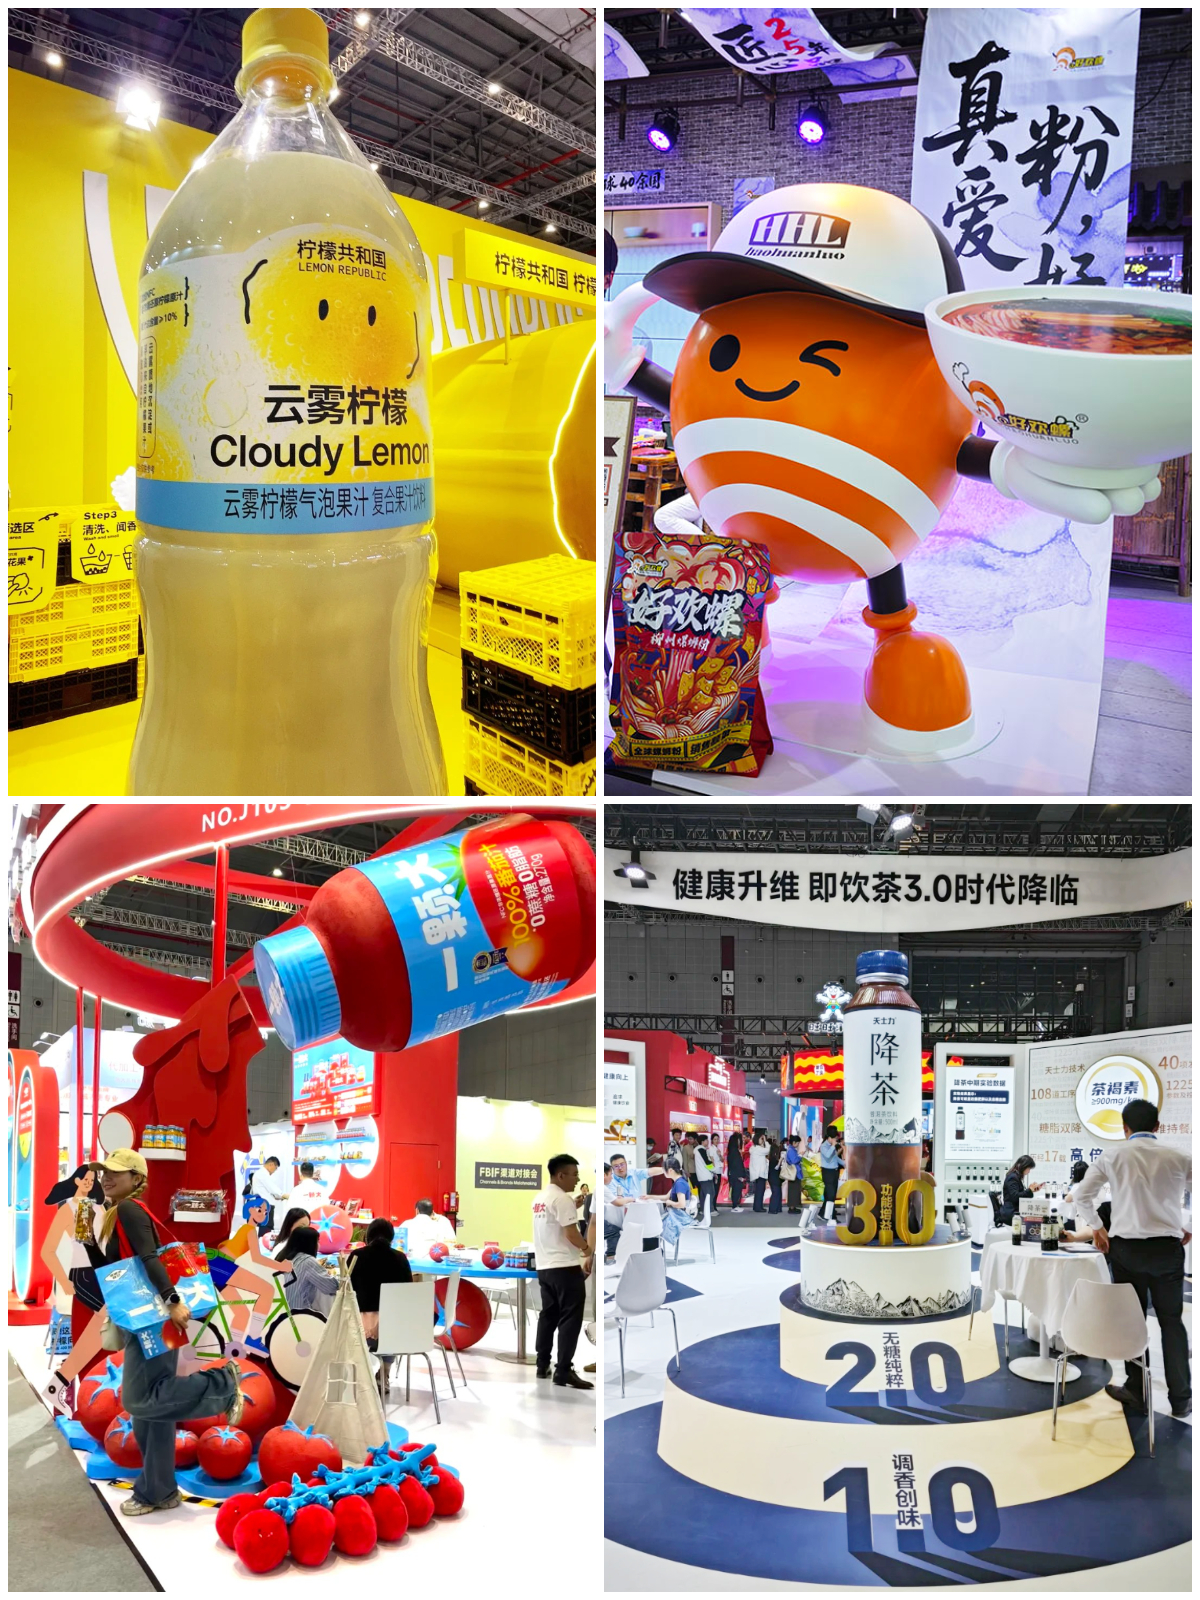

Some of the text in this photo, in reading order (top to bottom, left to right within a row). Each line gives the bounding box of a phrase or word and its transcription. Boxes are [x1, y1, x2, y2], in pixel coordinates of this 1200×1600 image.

[922, 41, 1028, 271] 真爱
[752, 211, 843, 246] HHL
[296, 239, 387, 269] 柠檬共和国
[298, 262, 387, 281] LEMON REPUBLIC
[494, 251, 569, 290] 柠檬共和国
[744, 246, 846, 260] haohuanluo
[264, 384, 408, 426] 云雾柠檬
[210, 433, 430, 477] Cloudy Lemon
[83, 510, 118, 521] Step3
[223, 483, 427, 520] 云雾柠檬气泡果汁 复合果汁饮料
[8, 522, 36, 534] 选区
[82, 520, 137, 536] 清洗、闻香
[628, 587, 744, 638] 好欢螺
[478, 843, 532, 950] 100%番茄汁
[672, 868, 1080, 907] 健康升维 即饮茶3.0时代降临
[394, 852, 468, 993] 一颗大
[872, 1017, 896, 1026] 天士力
[868, 1031, 900, 1107] 降茶
[953, 1079, 1007, 1088] 降茶中期实验数据
[1045, 1063, 1087, 1076] 天士力技术
[1030, 1087, 1076, 1101] 108道工序
[1091, 1080, 1140, 1097] 茶褐素
[1039, 1122, 1082, 1134] 糖脂双降
[835, 1178, 936, 1246] 3.0
[825, 1341, 966, 1407] 2.0
[882, 1332, 905, 1388] 无糖纯粹
[823, 1465, 1001, 1554] 1.0
[891, 1454, 921, 1528] 调香创味
